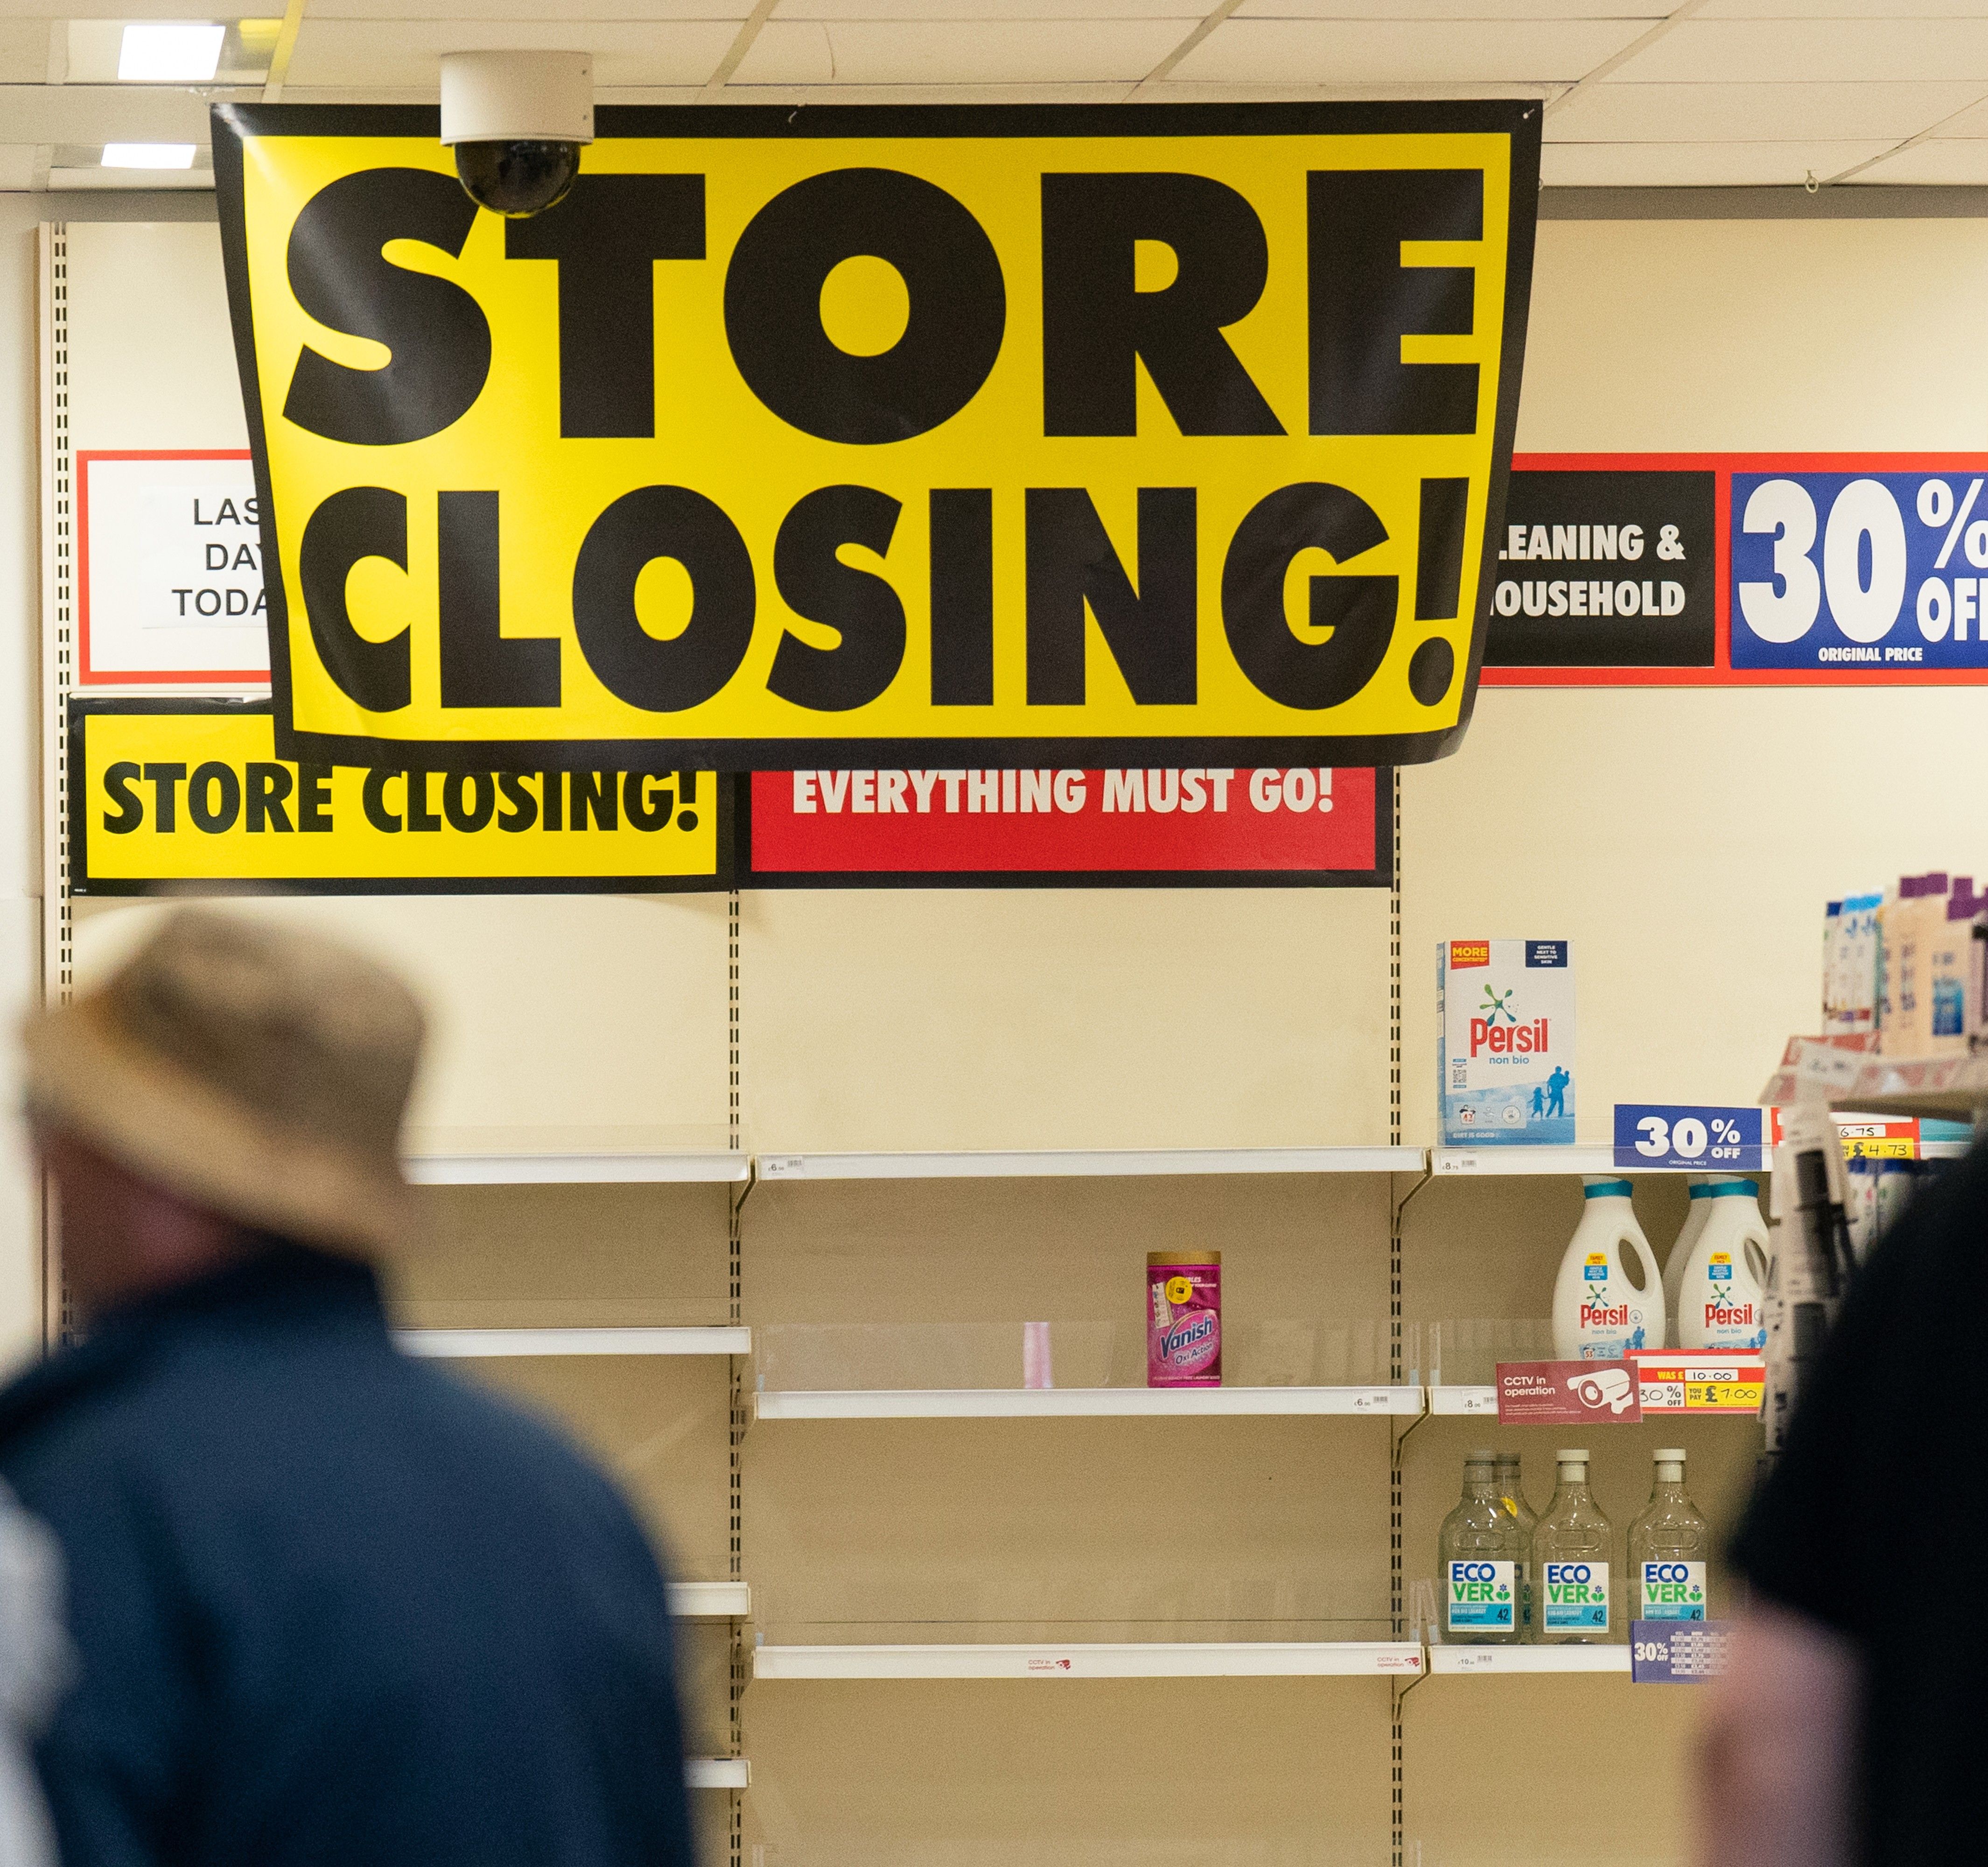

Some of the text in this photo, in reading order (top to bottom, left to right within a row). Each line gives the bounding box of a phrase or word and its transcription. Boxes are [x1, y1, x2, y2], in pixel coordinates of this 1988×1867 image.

[282, 166, 1484, 444] STORE
[194, 498, 259, 525] LAS
[1498, 525, 1686, 560] EANING &
[206, 544, 262, 570] DA
[171, 589, 268, 616] TODA
[299, 477, 1470, 712] CLOSING!
[1490, 581, 1686, 617] OUSEHOLD
[1818, 647, 1923, 661] ORIGINAL PRICE
[104, 761, 699, 834] STORE CLOSING!
[793, 768, 1333, 814] EVERYTHING MUST GO!
[1452, 948, 1488, 957] MORE
[1470, 1018, 1548, 1057] Persil
[1512, 1056, 1529, 1064] bio
[1711, 1147, 1741, 1159] OFF
[1581, 1305, 1628, 1328] Persil
[1705, 1304, 1752, 1328] Persil
[1161, 1316, 1212, 1359] Vanish
[1176, 1341, 1213, 1364] Oxi Action
[1504, 1376, 1546, 1386] CCTV in
[1657, 1371, 1732, 1380] WAS £ 10.00
[1505, 1386, 1555, 1397] operation
[1452, 1563, 1495, 1582] ECO
[1548, 1565, 1591, 1584] ECO
[1645, 1564, 1688, 1583] ECO
[1452, 1583, 1494, 1601] VER
[1548, 1585, 1590, 1603] VER
[1645, 1584, 1688, 1602] VER
[1497, 1608, 1509, 1621] 42
[1592, 1610, 1603, 1622] 42
